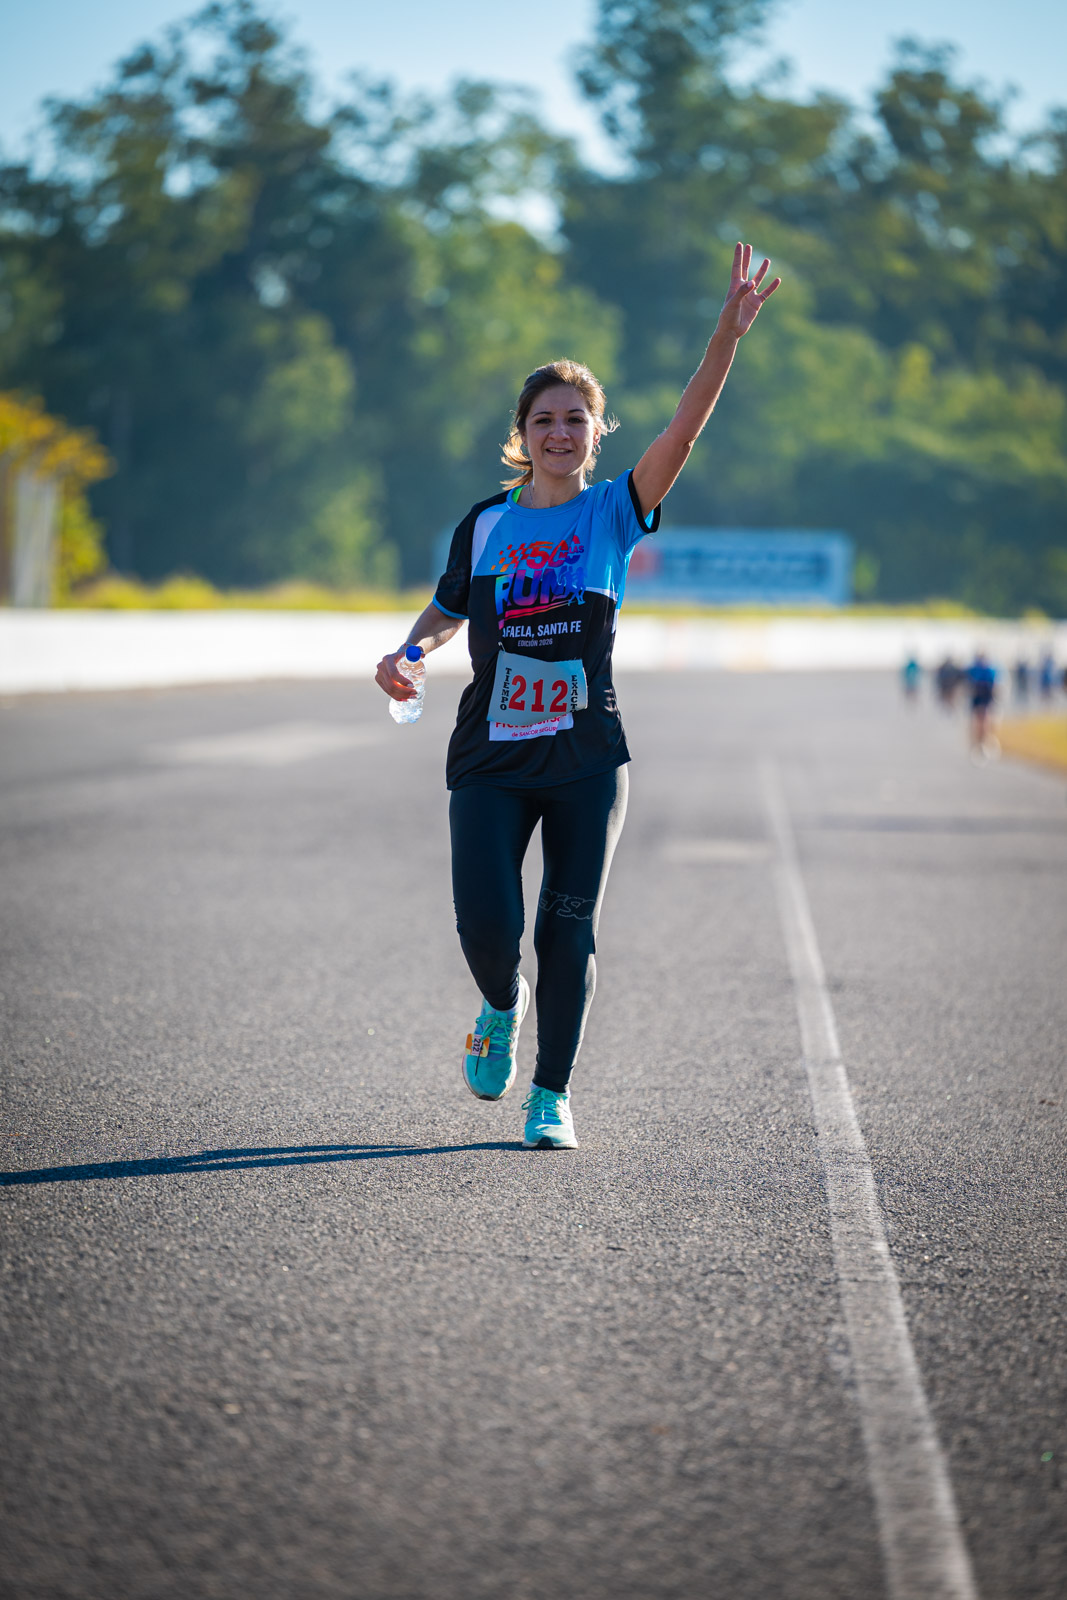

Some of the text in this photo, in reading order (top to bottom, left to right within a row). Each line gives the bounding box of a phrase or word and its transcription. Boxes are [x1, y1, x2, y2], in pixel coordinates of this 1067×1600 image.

[558, 545, 585, 559] MLAS
[502, 620, 582, 639] AFAELA, SANTA FE
[517, 639, 538, 647] EDICIÓN
[499, 667, 512, 711] TIEMPO
[508, 674, 569, 713] 212
[519, 729, 539, 738] SANCOR
[539, 726, 558, 735] SEGUR
[473, 1038, 481, 1052] 212
